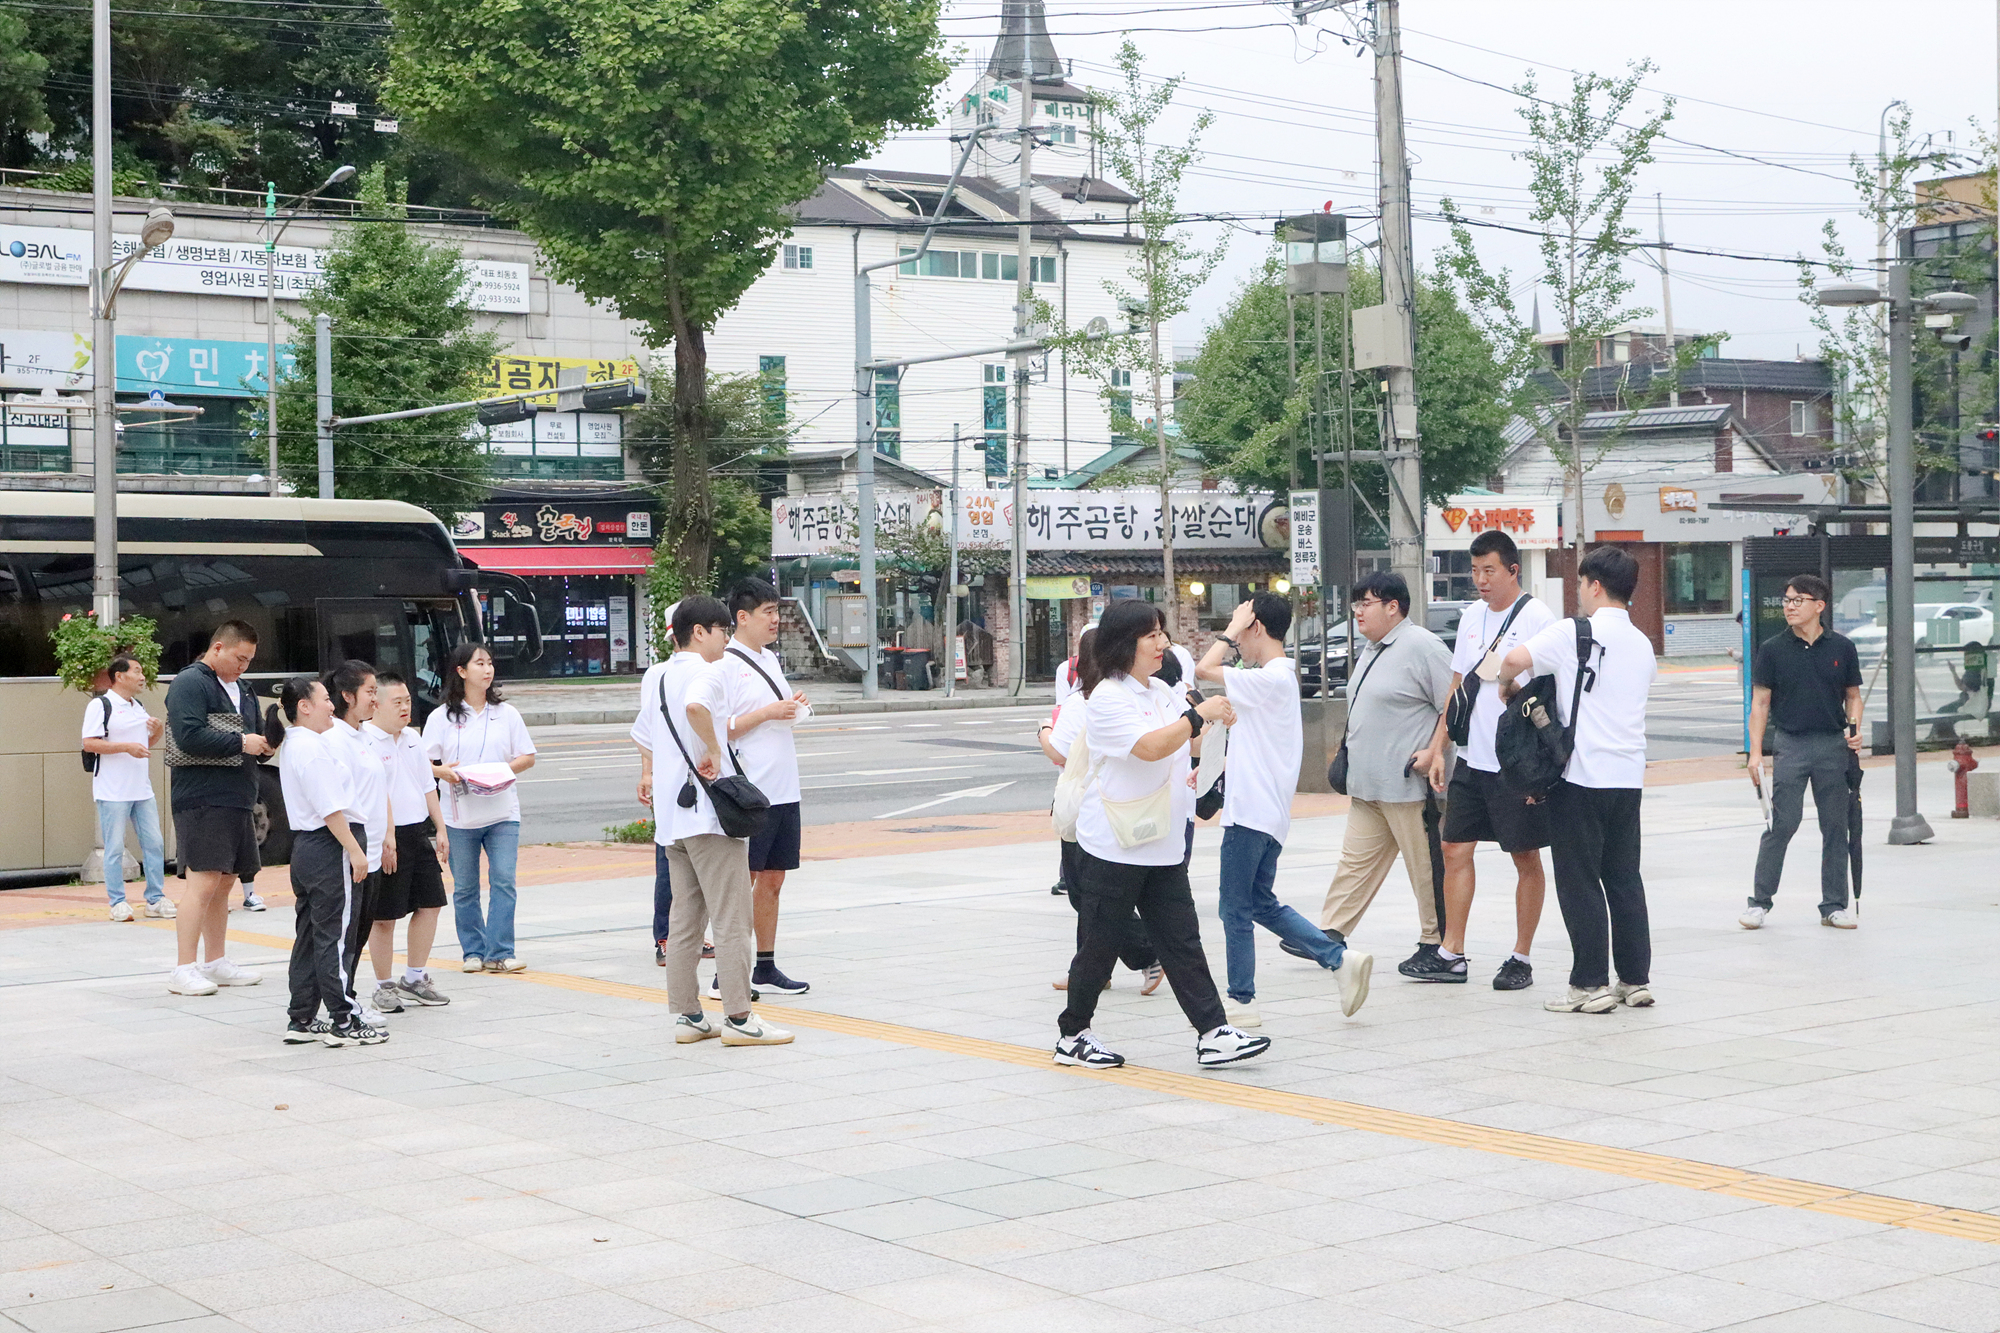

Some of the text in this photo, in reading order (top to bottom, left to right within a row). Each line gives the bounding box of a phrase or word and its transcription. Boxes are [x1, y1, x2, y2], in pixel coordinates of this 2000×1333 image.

[112, 239, 166, 259] 손해험
[176, 245, 231, 264] 생명보험
[69, 263, 83, 273] 판매
[201, 269, 255, 288] 영업사원
[480, 268, 518, 280] 대표 최동호
[469, 280, 521, 291] 01-9936-5924
[478, 294, 521, 304] 02-933-5924
[28, 354, 41, 364] 2F
[622, 364, 634, 375] 2F
[549, 421, 562, 430] 무료
[587, 422, 612, 431] 영업사원
[498, 430, 524, 438] 보험회사
[547, 432, 566, 440] 컨설팅
[594, 432, 606, 440] 모집
[968, 510, 994, 526] 영업
[1293, 510, 1316, 522] 예비군
[1468, 508, 1535, 533] 슈퍼맥주
[631, 521, 649, 532] 한돈
[1297, 524, 1313, 536] 운송
[972, 528, 989, 539] 본점
[1297, 538, 1313, 549] 버스
[1294, 551, 1317, 564] 정류장
